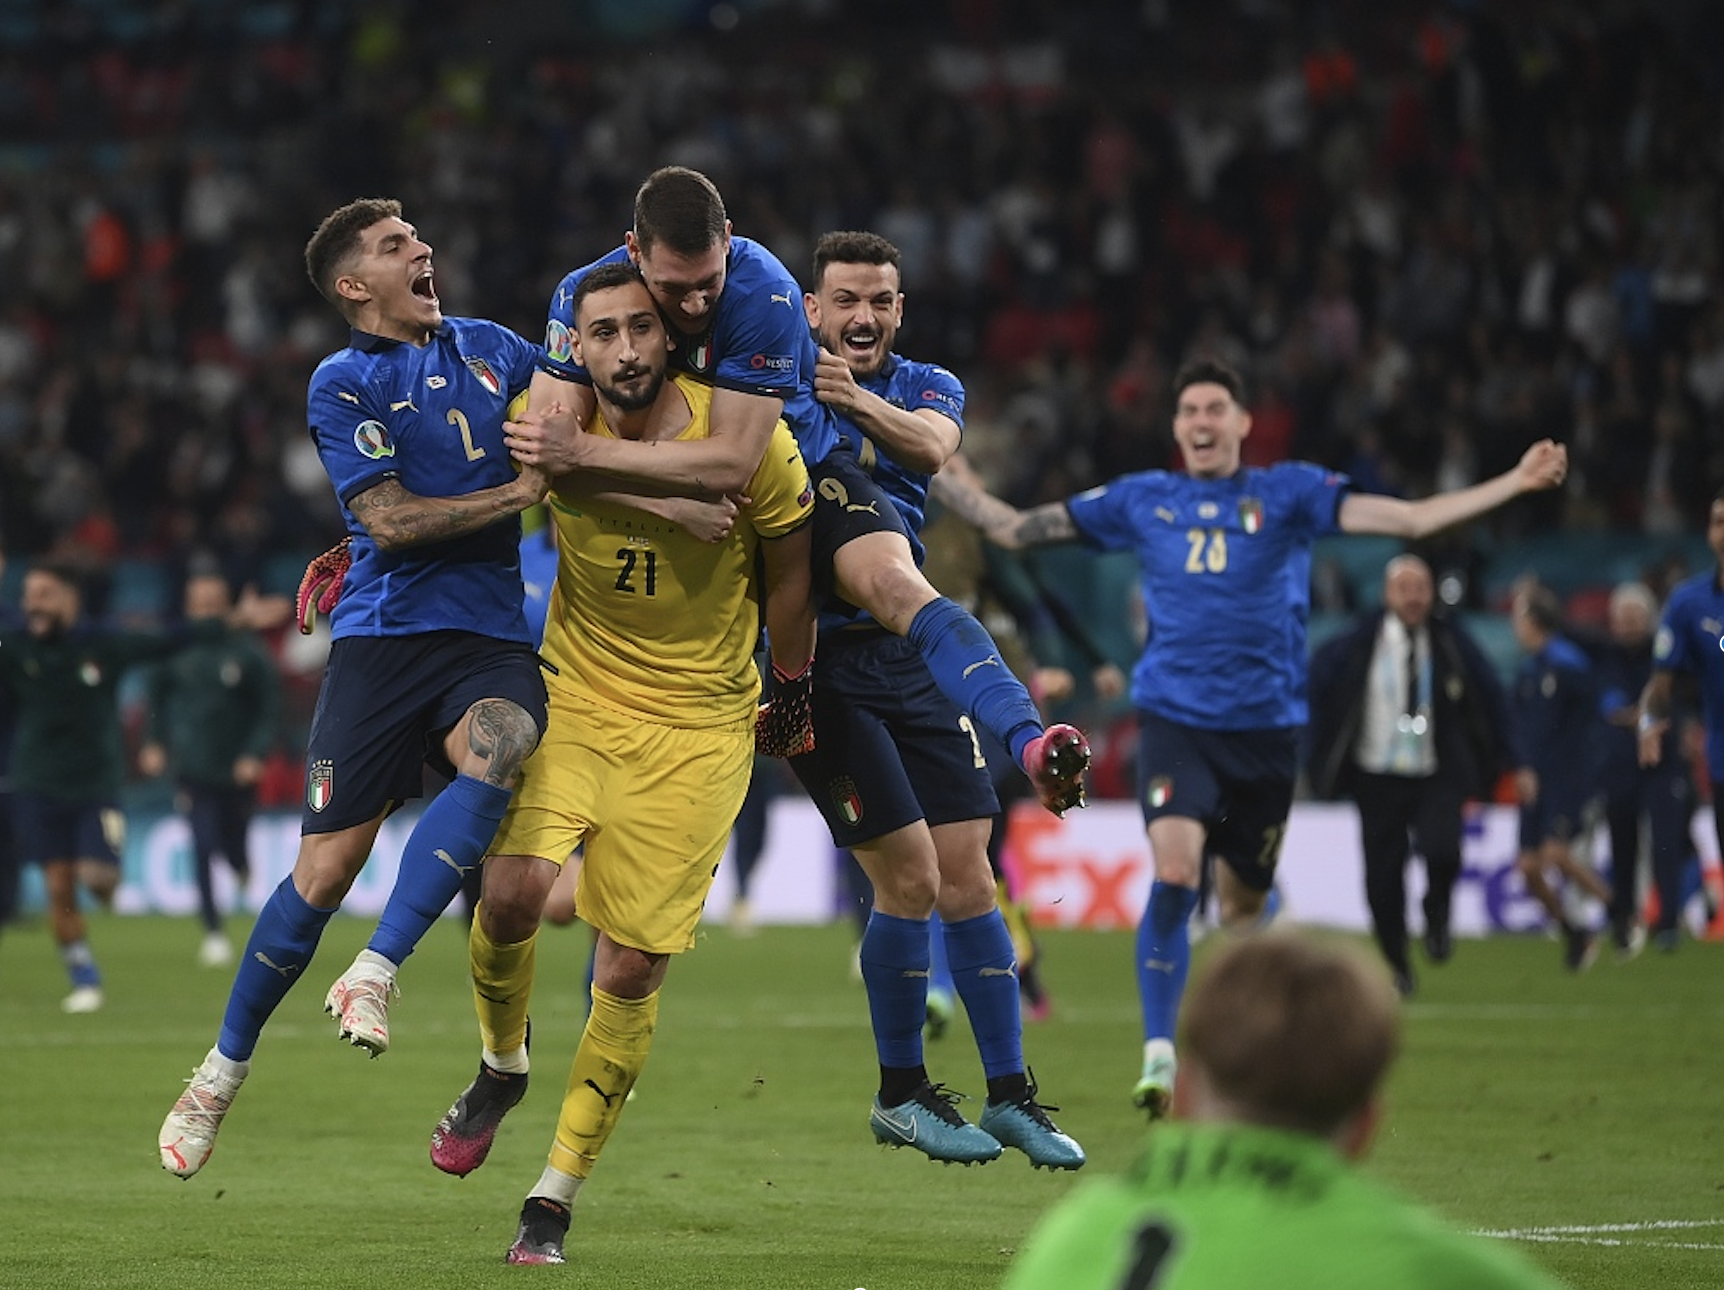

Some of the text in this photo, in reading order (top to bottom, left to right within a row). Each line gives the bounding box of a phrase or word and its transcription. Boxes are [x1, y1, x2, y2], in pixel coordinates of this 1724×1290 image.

[446, 408, 486, 462] 2
[817, 476, 849, 507] 9
[614, 546, 656, 596] 21
[957, 714, 987, 769] 2
